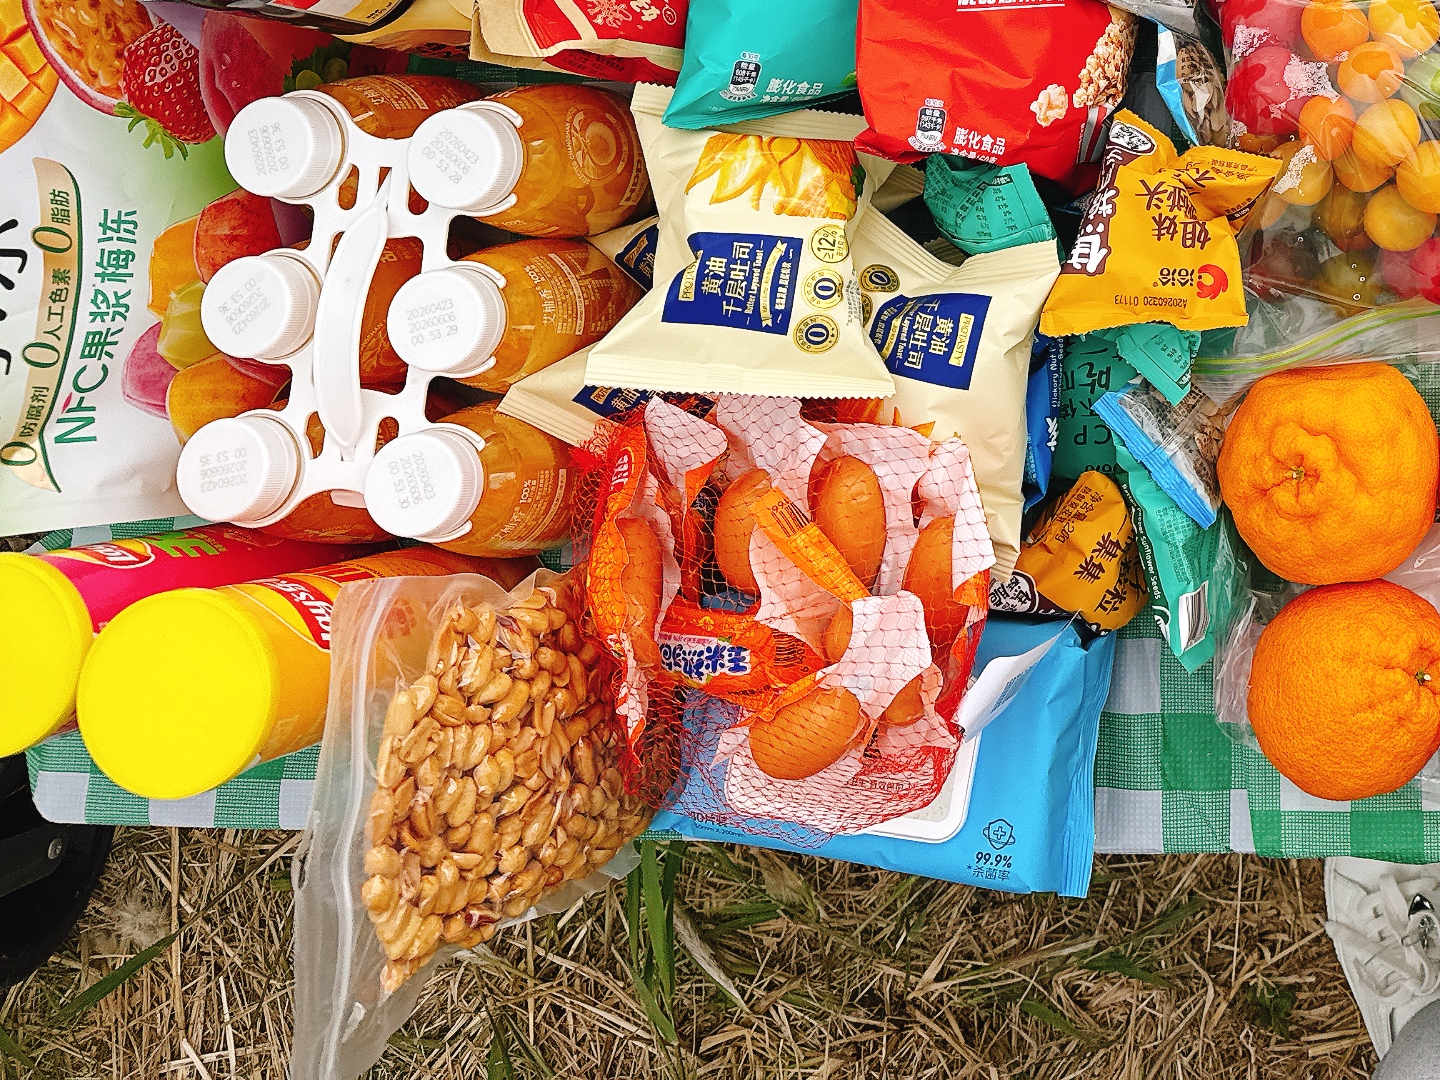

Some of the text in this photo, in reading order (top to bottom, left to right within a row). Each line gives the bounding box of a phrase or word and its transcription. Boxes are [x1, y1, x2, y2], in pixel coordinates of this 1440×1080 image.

[765, 77, 825, 96] 膨化食品
[952, 125, 1007, 157] 膨化食品
[32, 188, 73, 254] 0脂肪
[1150, 212, 1212, 251] 姐妹
[701, 256, 728, 296] 黄油
[754, 249, 764, 268] Toast
[1159, 267, 1195, 287] 洽洽
[722, 241, 754, 317] 千层吐司
[748, 268, 761, 294] Layered
[22, 267, 71, 369] 0人工色素
[903, 298, 941, 369] 千层吐司
[928, 314, 955, 355] 黄油
[953, 316, 972, 366] PROTASTY
[0, 385, 50, 466] 0防腐剂
[1073, 424, 1112, 446] CP
[519, 480, 532, 504] 100%
[1073, 531, 1123, 584] 集集
[1140, 536, 1156, 575] Sunflower
[1149, 575, 1162, 600] Seeds
[971, 867, 1011, 882] 杀菌率
[974, 851, 1013, 869] 99.9%
